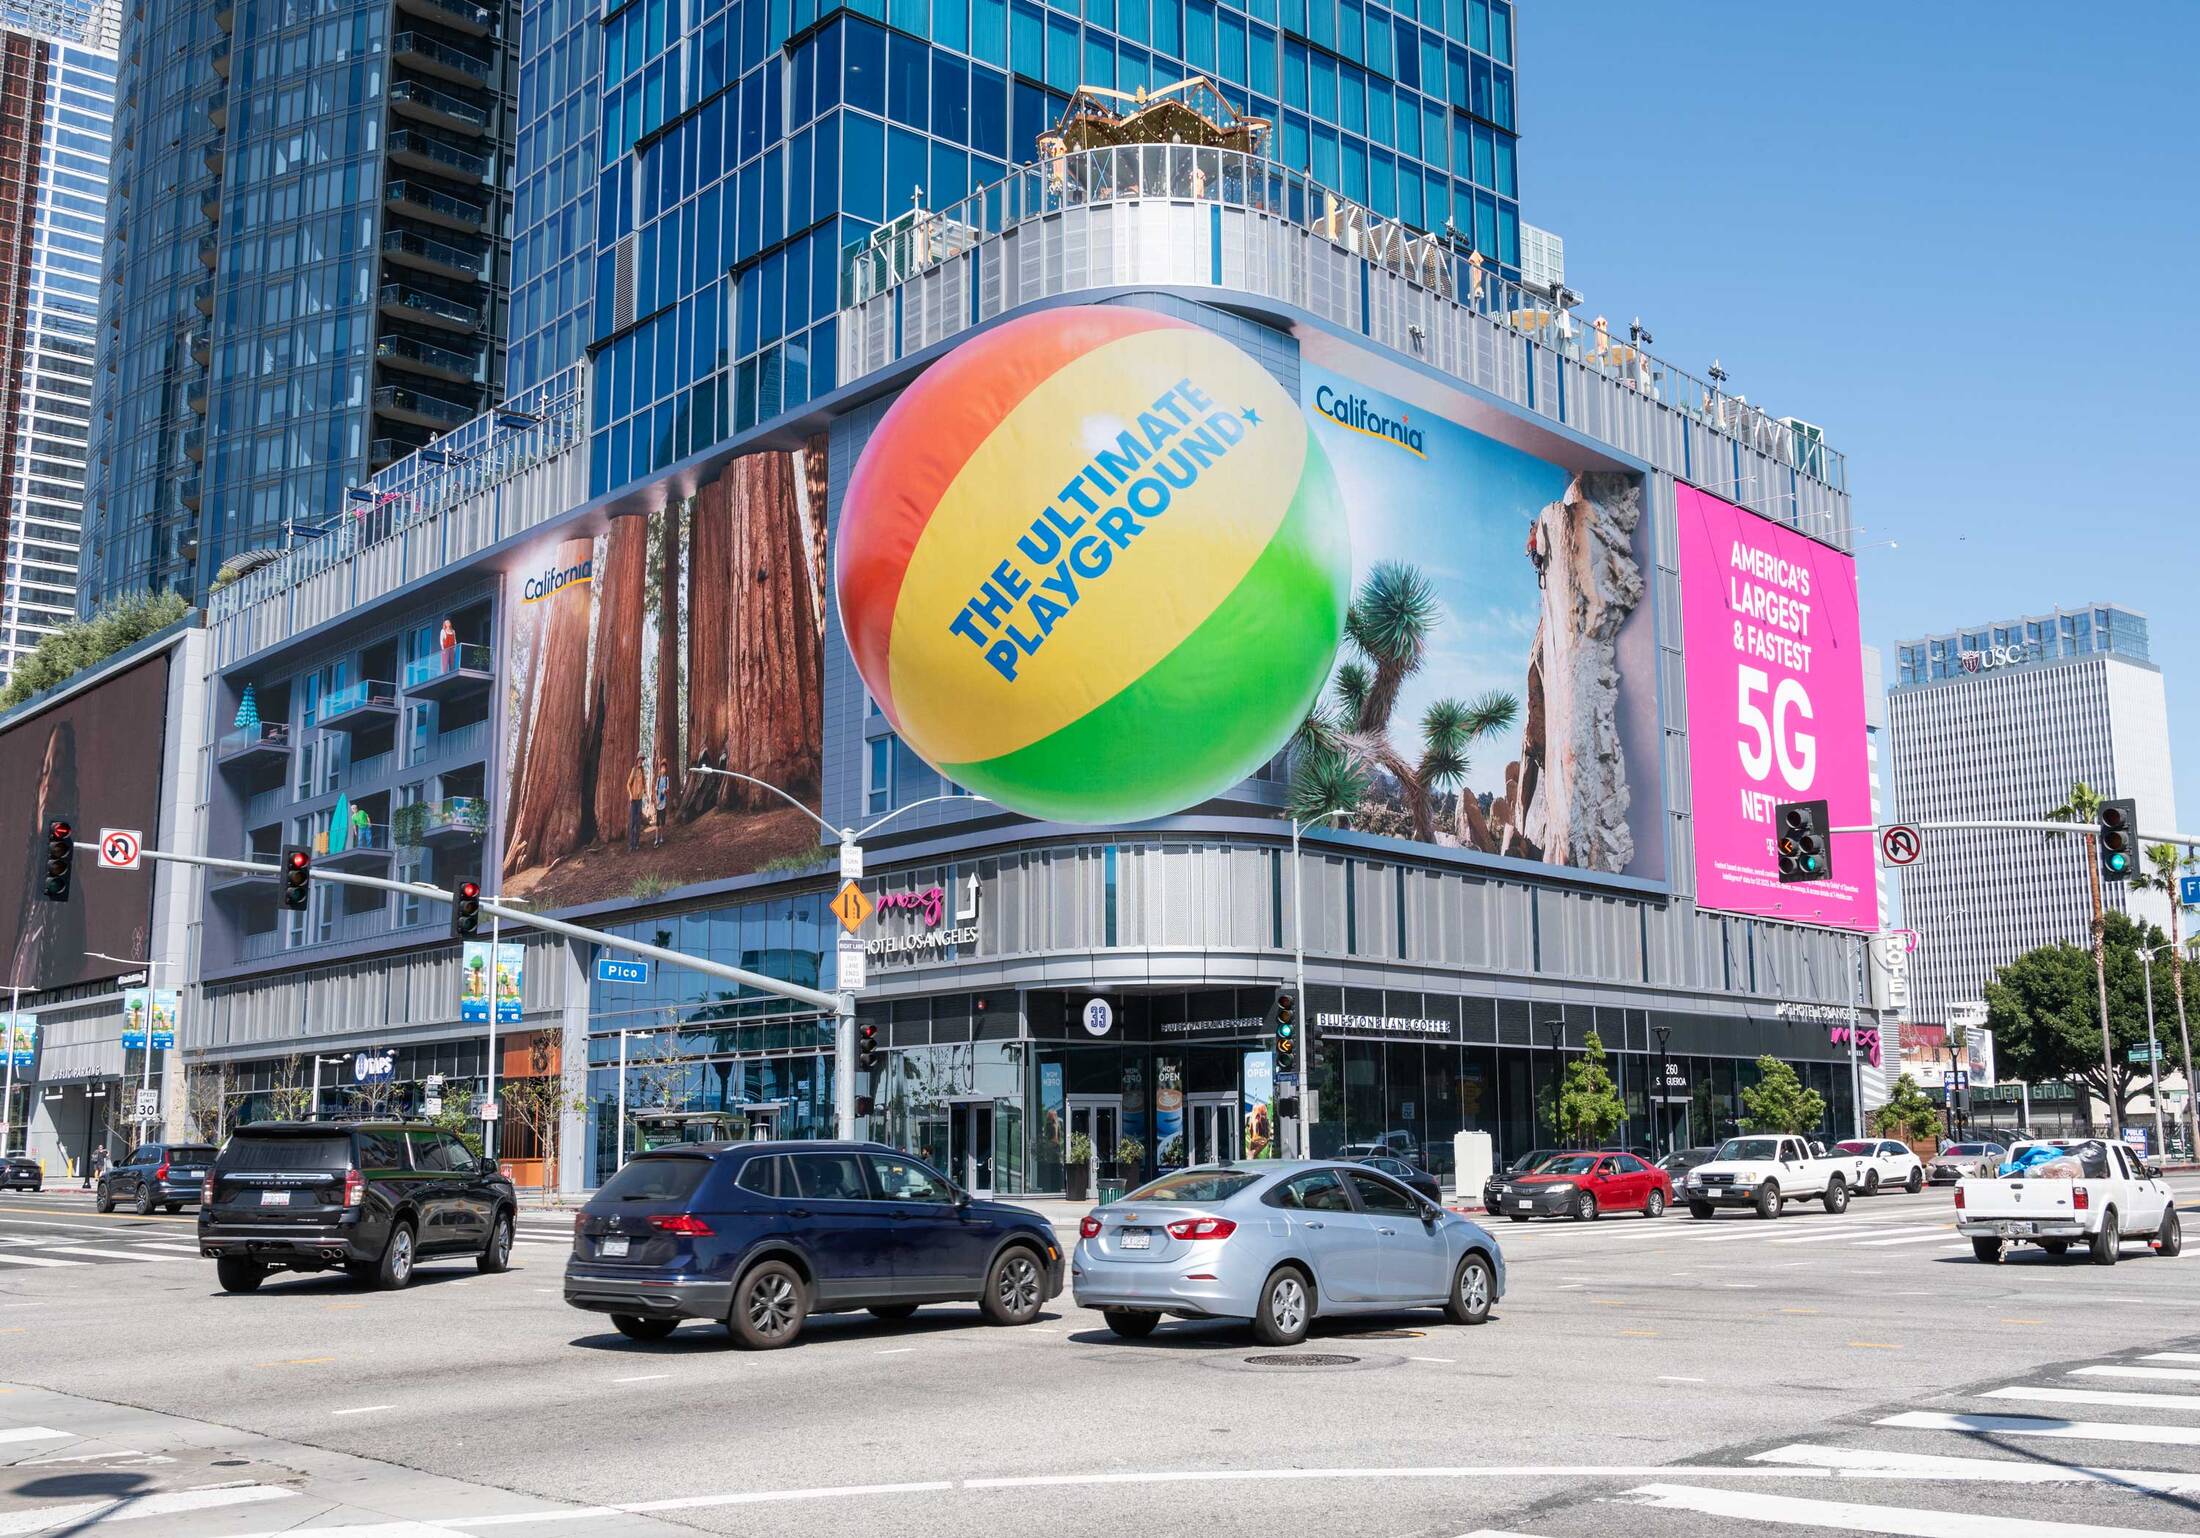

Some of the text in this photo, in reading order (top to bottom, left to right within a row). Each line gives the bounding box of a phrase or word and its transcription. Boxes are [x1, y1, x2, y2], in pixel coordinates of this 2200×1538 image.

[1316, 385, 1423, 453] California
[949, 377, 1213, 648] THE ULTIMATE
[984, 411, 1245, 683] PLAYGROUND
[524, 553, 593, 600] California
[1730, 540, 1810, 596] AMERICA'S
[1731, 576, 1811, 636] LARGEST
[1733, 619, 1812, 673] & FASTEST
[1981, 644, 2021, 668] USC
[1738, 663, 1817, 791] 5G
[877, 887, 945, 927] moxy
[900, 933, 925, 950] LOS
[924, 926, 978, 947] ANGELES
[608, 965, 638, 978] Pico
[1090, 1006, 1107, 1028] 33
[1410, 1019, 1451, 1033] COFFEE
[1159, 1072, 1180, 1082] OPEN
[1247, 1068, 1270, 1078] OPEN
[1665, 1063, 1678, 1075] 260
[140, 1105, 155, 1115] 30
